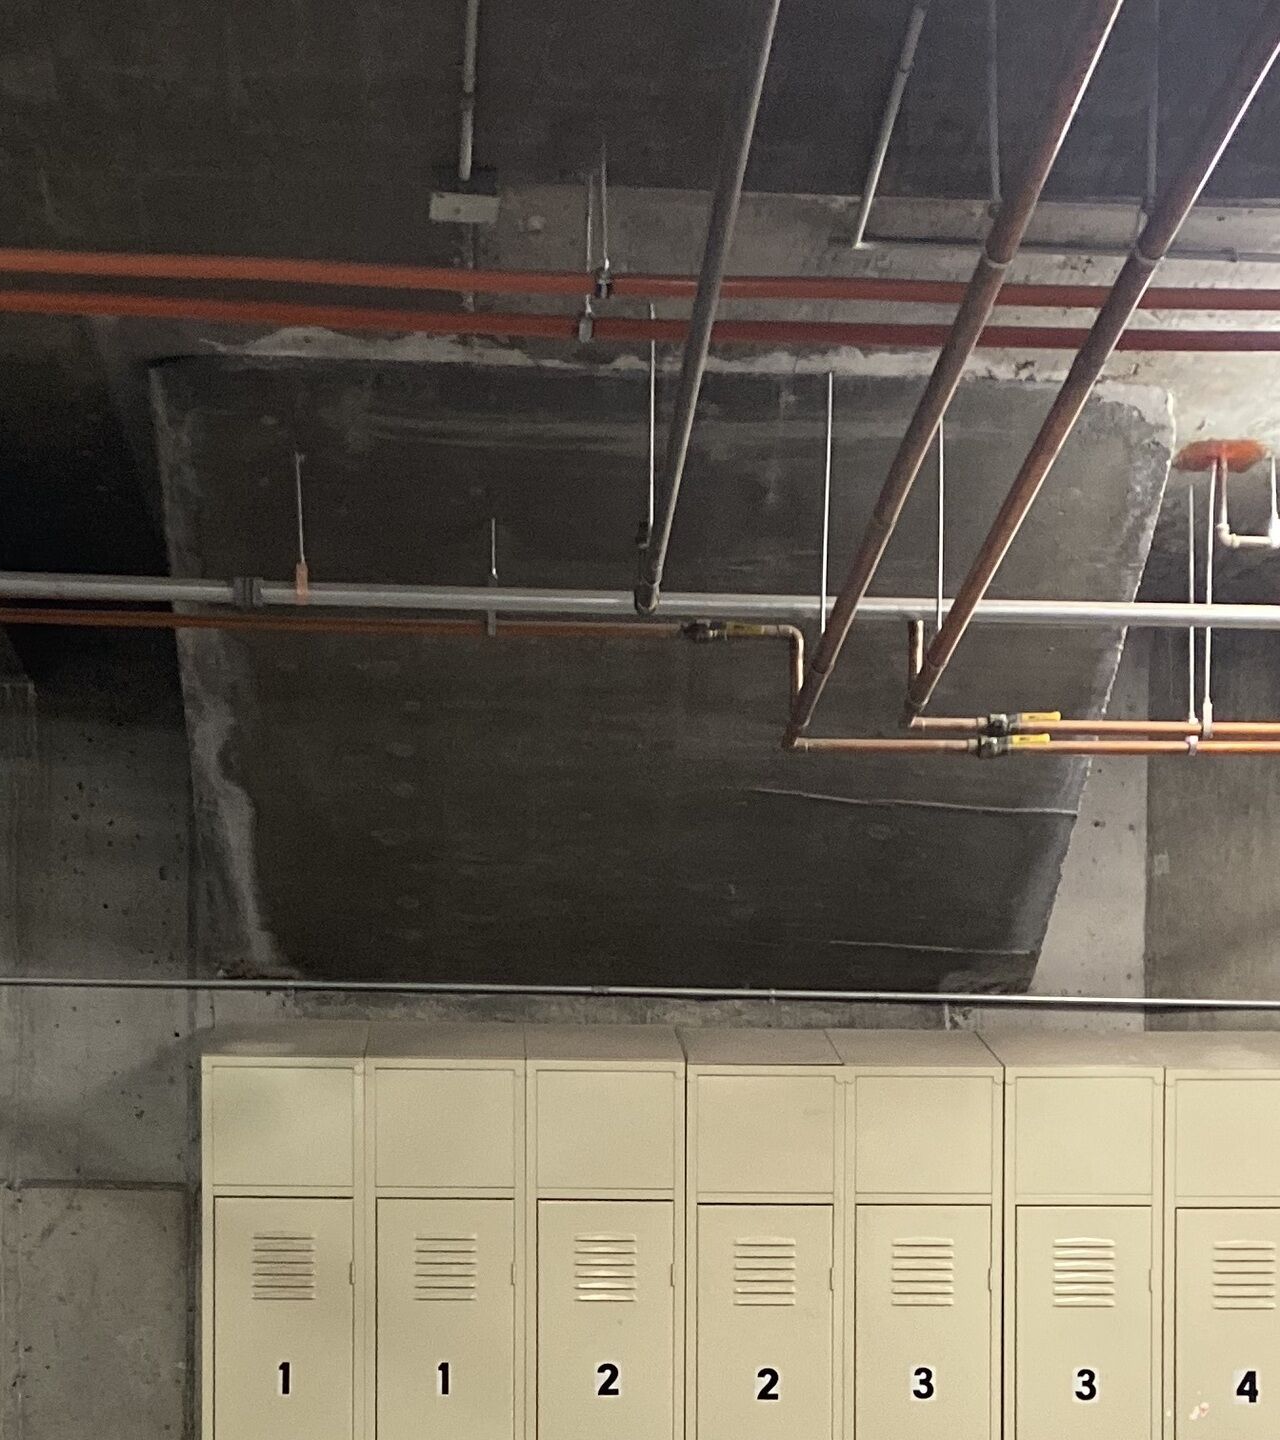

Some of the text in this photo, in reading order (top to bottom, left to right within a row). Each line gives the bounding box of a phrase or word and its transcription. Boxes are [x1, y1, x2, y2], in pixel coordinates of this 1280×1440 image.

[278, 1361, 290, 1395] 1
[437, 1362, 449, 1395] 1
[597, 1363, 619, 1396] 2
[756, 1367, 779, 1401] 2
[912, 1367, 934, 1400] 3
[1075, 1368, 1097, 1401] 3
[1236, 1370, 1259, 1403] 4
